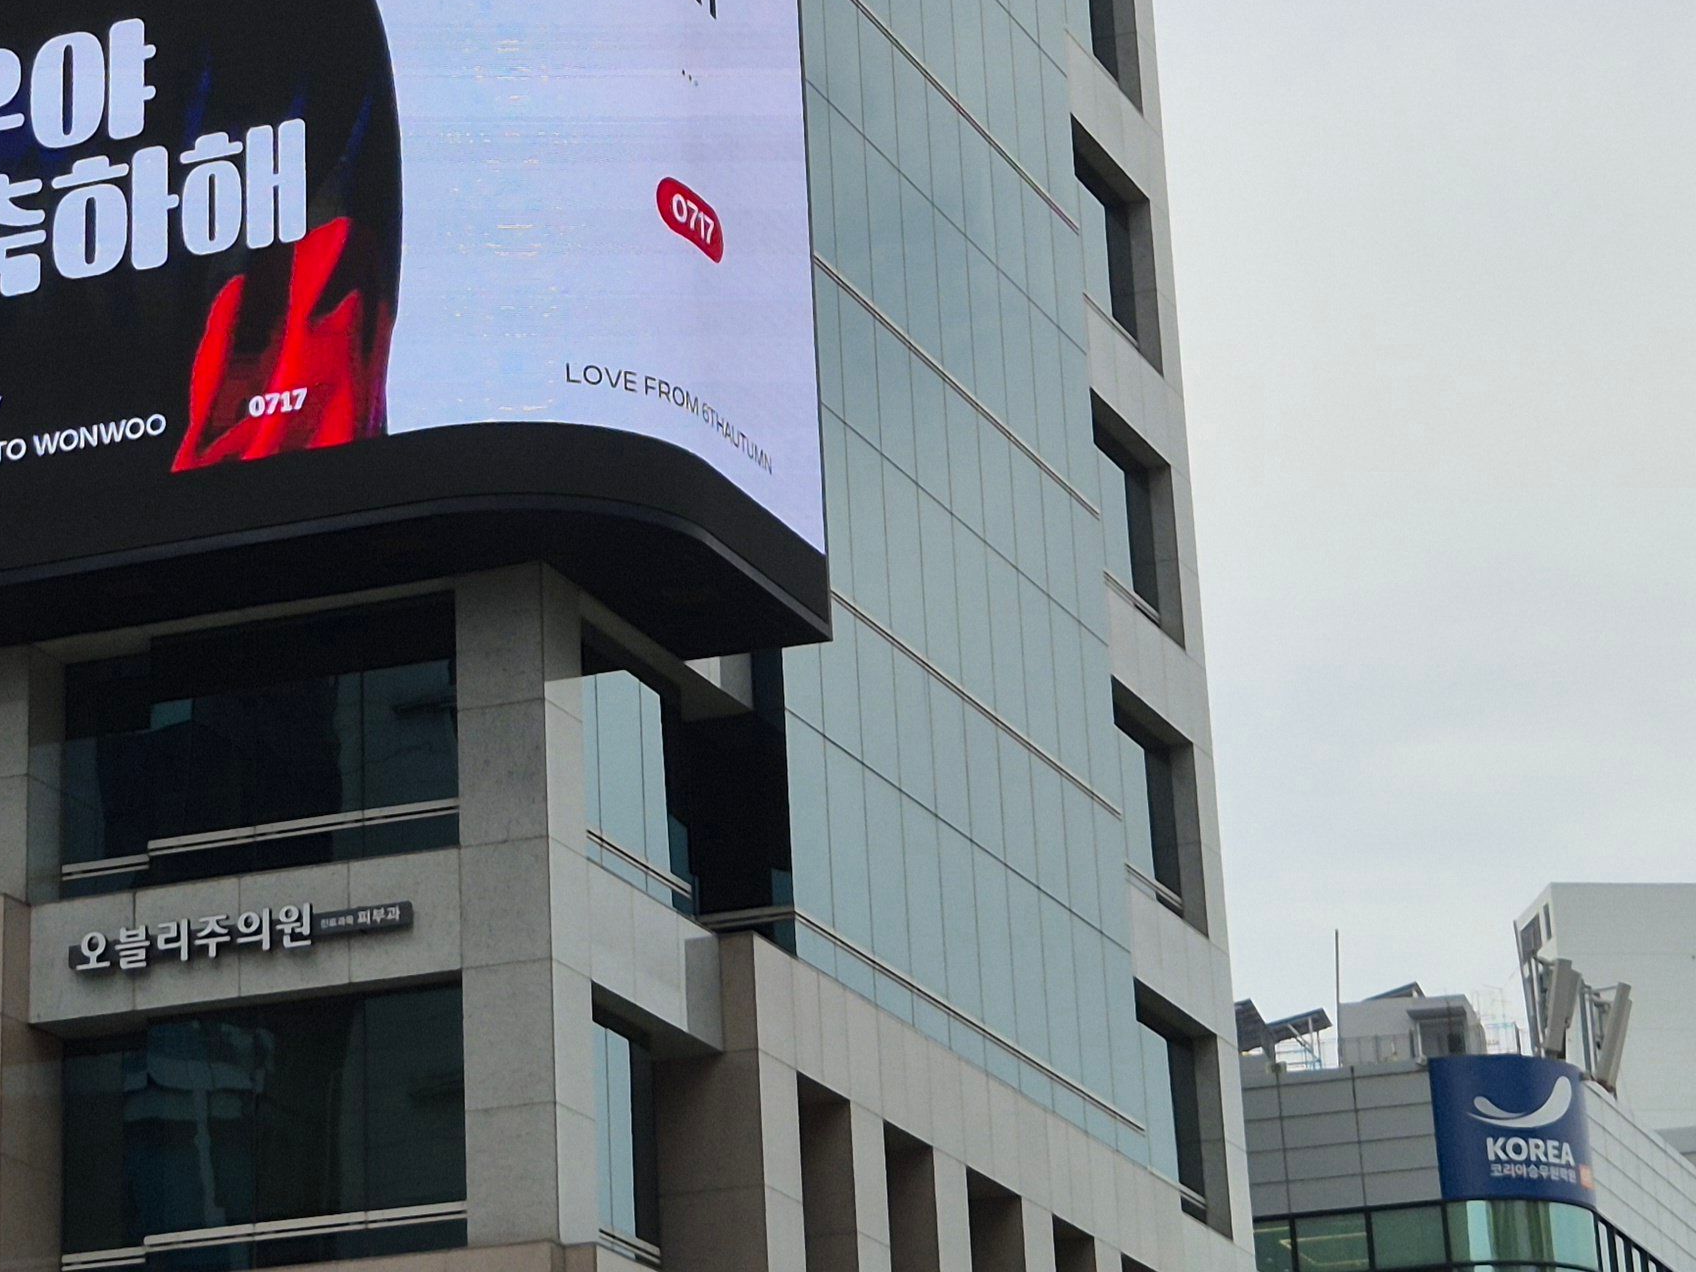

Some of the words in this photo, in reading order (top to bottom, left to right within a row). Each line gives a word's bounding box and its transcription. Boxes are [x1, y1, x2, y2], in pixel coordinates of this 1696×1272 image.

[672, 193, 715, 245] 0717
[248, 388, 308, 418] 0717
[565, 362, 637, 393] LOVE
[644, 375, 699, 416] FROM
[33, 413, 167, 457] WONWOO
[76, 902, 312, 970] 오블리주의원
[357, 905, 401, 925] 피부과
[1486, 1136, 1575, 1167] KOREA
